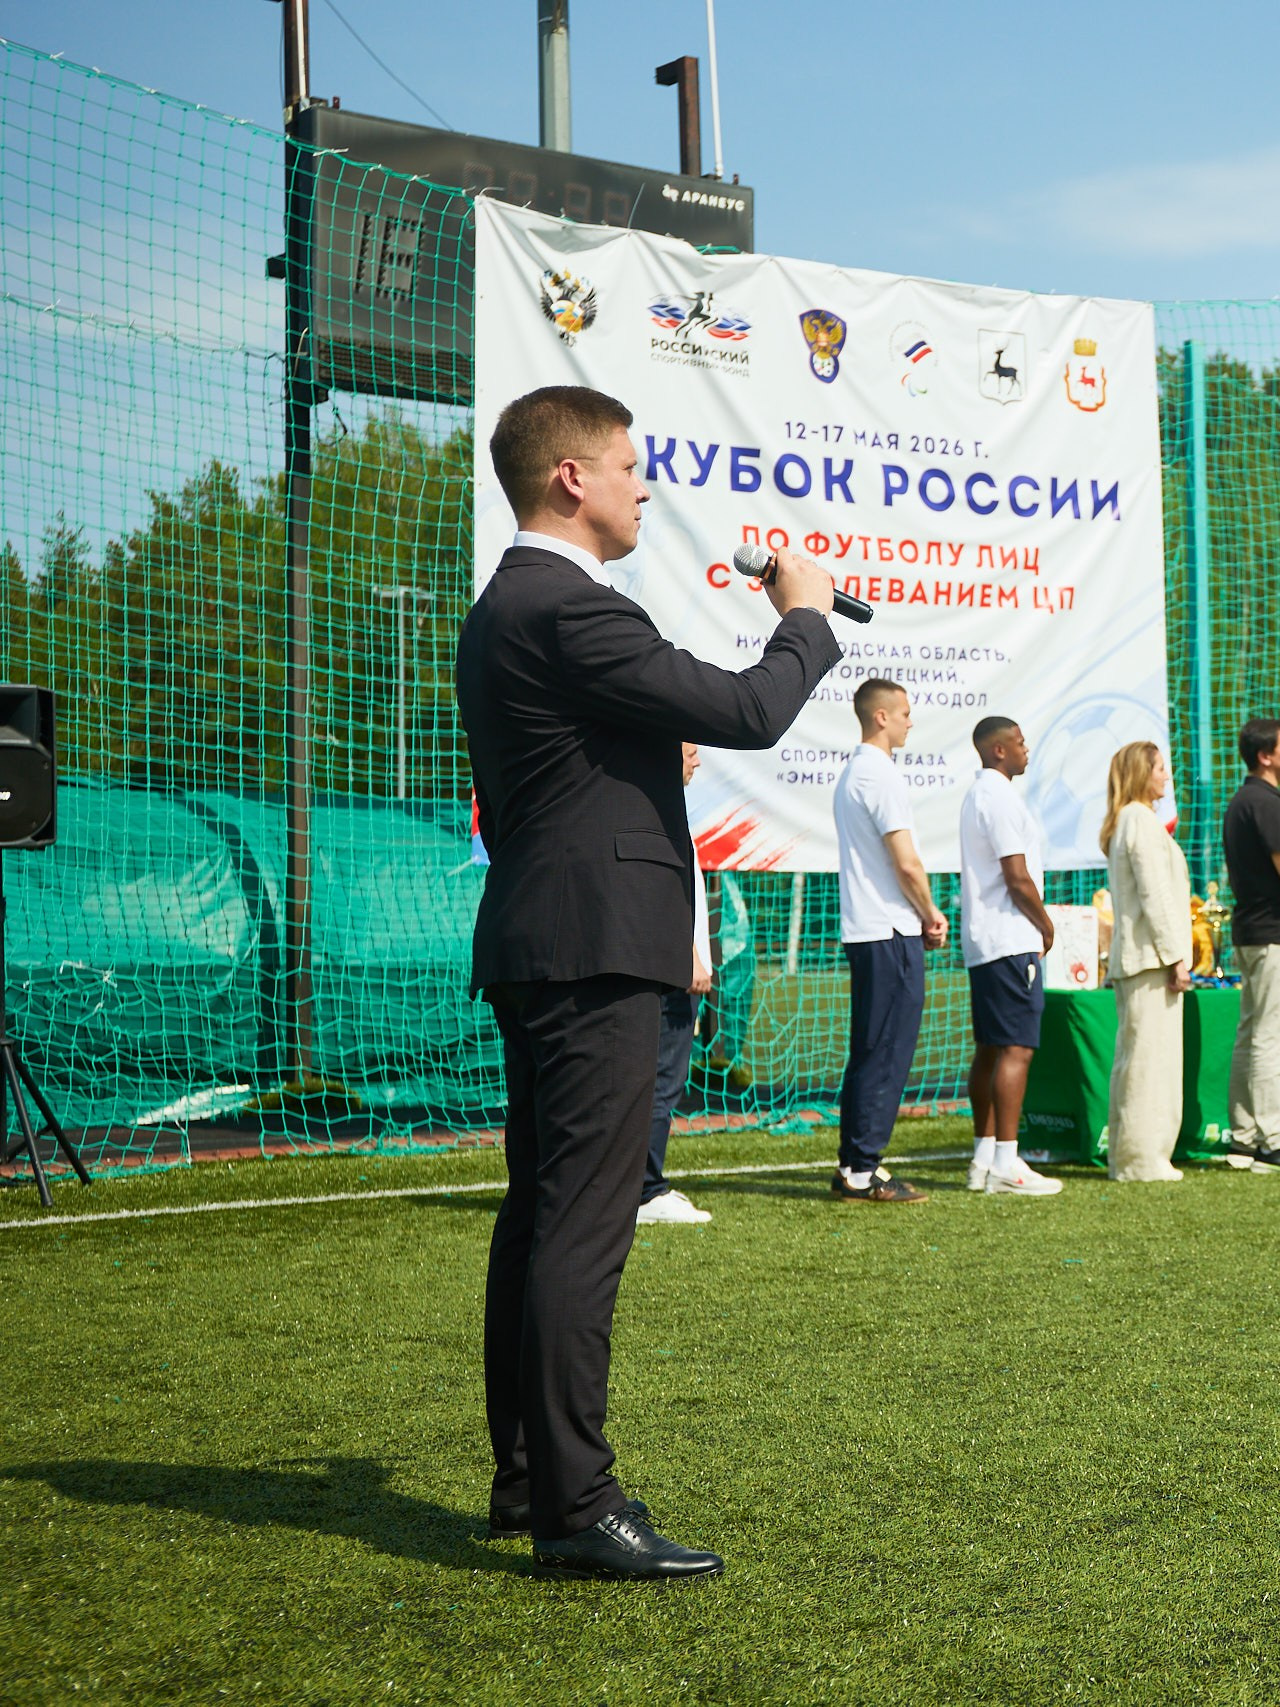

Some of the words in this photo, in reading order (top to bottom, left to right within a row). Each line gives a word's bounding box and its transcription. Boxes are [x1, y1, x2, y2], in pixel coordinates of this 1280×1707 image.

[785, 421, 843, 443] 12-17
[854, 429, 899, 451] МАЯ
[910, 435, 964, 456] 2026
[974, 441, 989, 458] Г.
[644, 434, 856, 504] КУБОК
[882, 463, 1122, 521] РОССИИ
[742, 525, 790, 550] ПО
[804, 531, 964, 569] ФУТБОЛУ
[977, 545, 1039, 575] ЛИЦ
[706, 563, 731, 588] С
[1033, 586, 1075, 614] ЦП
[920, 645, 1011, 664] ОБЛАСТЬ,
[912, 692, 988, 709] УХОДОЛ
[904, 752, 947, 766] БАЗА
